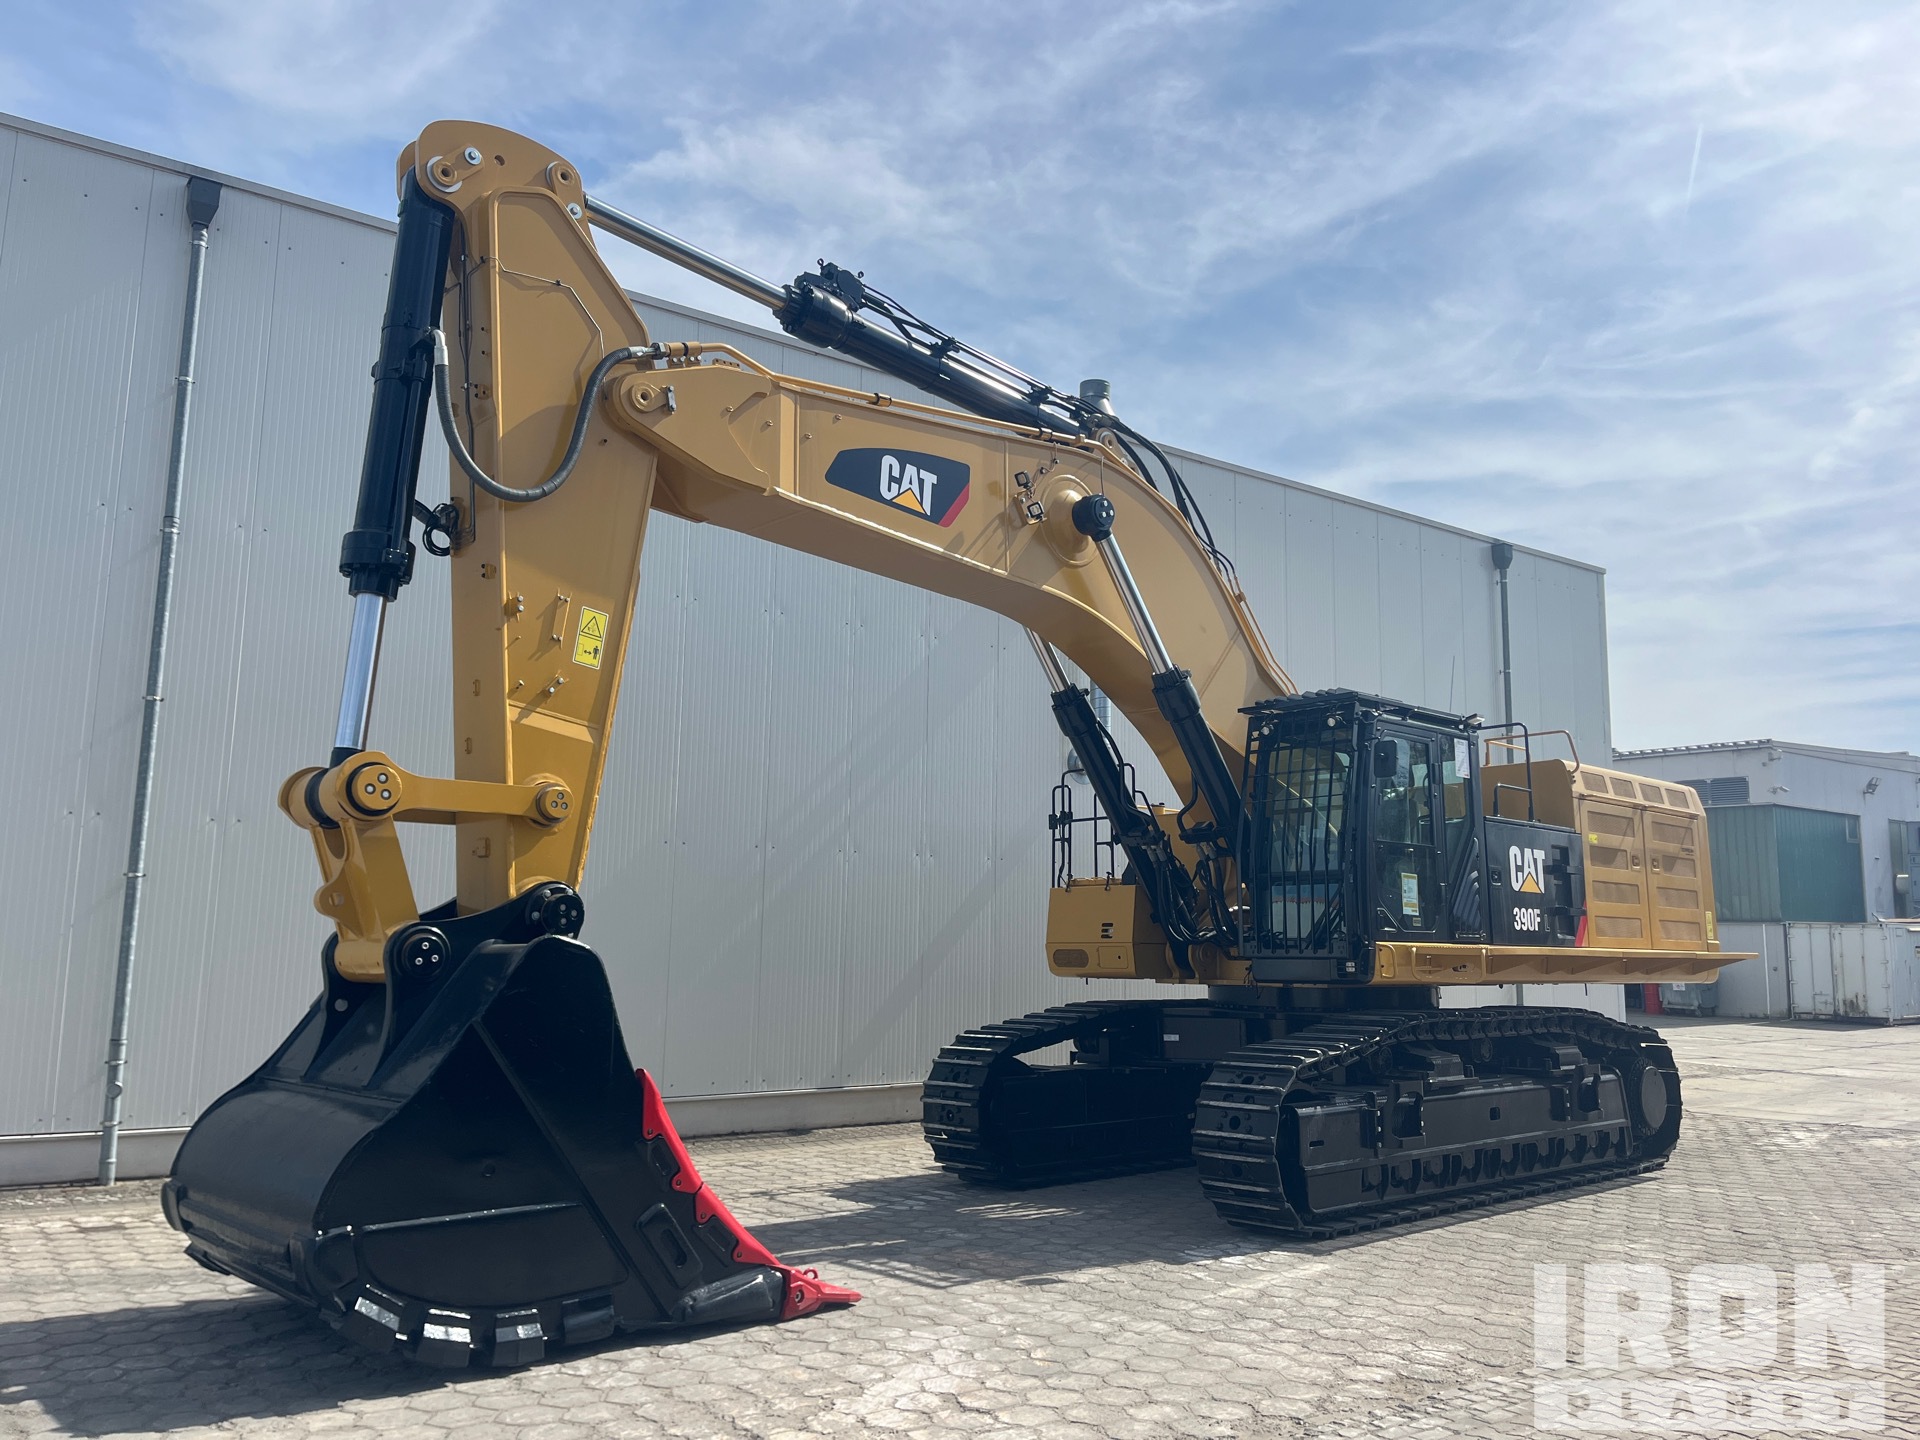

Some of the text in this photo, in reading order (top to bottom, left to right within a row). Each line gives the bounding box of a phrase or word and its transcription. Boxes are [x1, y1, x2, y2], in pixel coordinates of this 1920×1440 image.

[879, 454, 938, 516] CAT
[1509, 845, 1545, 894] CAT
[1513, 907, 1541, 931] 390F
